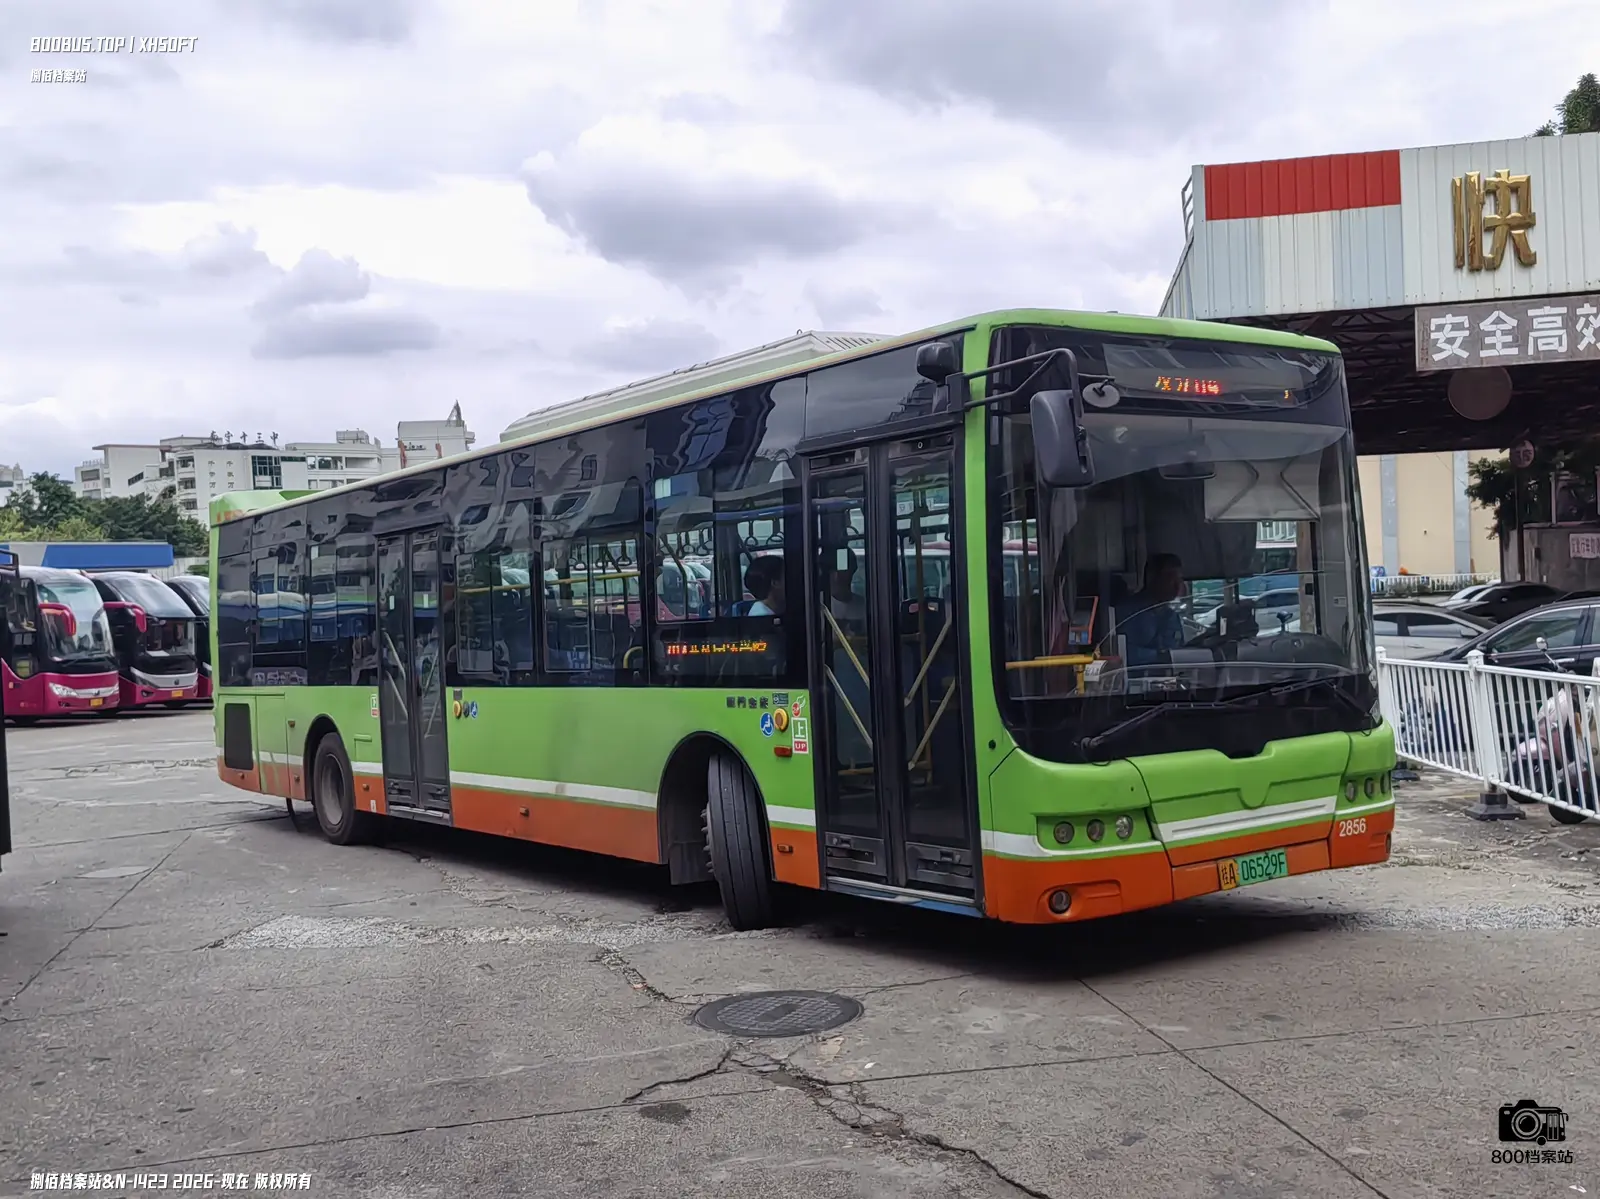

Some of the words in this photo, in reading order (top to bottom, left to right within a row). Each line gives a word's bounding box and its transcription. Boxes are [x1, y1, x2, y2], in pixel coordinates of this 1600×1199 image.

[1451, 168, 1537, 272] 快
[794, 721, 806, 738] 上
[1339, 818, 1366, 837] 2856
